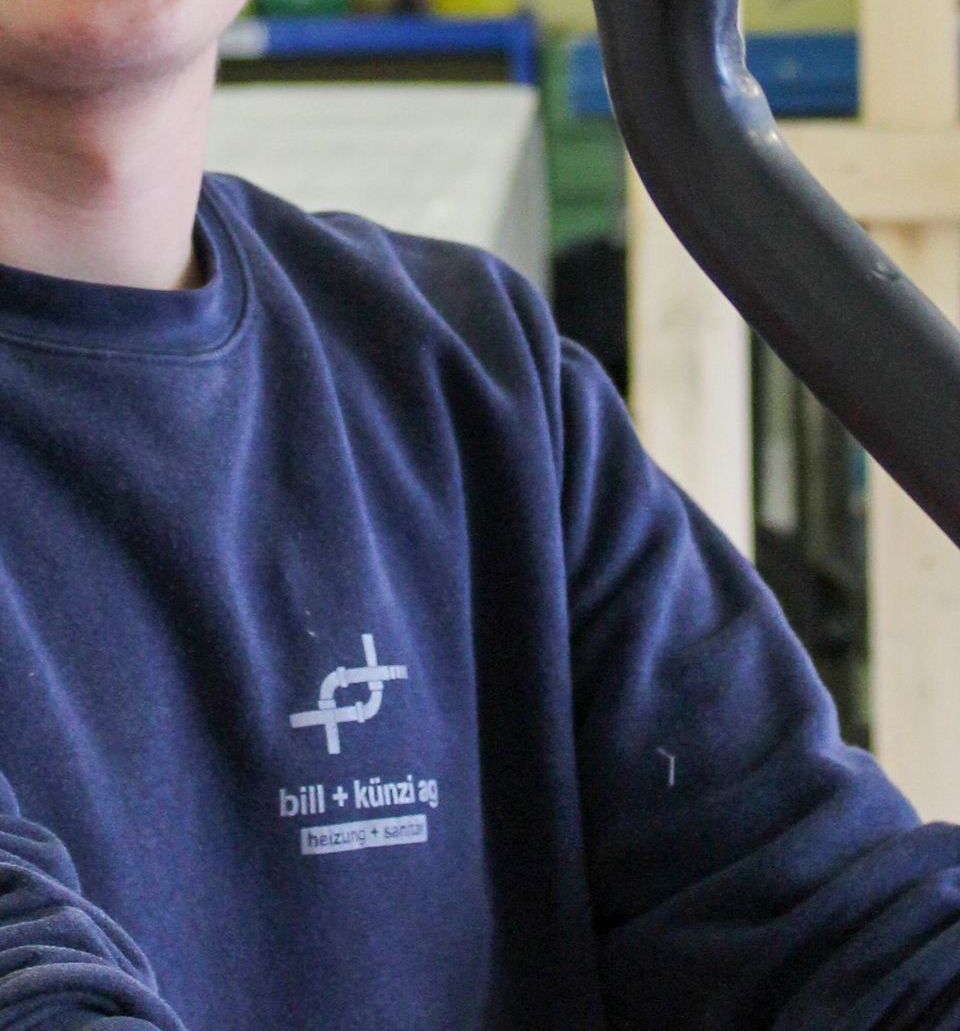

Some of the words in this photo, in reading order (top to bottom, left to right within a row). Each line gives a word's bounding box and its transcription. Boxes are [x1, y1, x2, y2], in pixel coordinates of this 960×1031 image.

[279, 784, 326, 817] bill
[332, 785, 349, 807] +
[353, 774, 416, 809] künzi
[418, 778, 439, 808] ag
[307, 829, 366, 848] heizung
